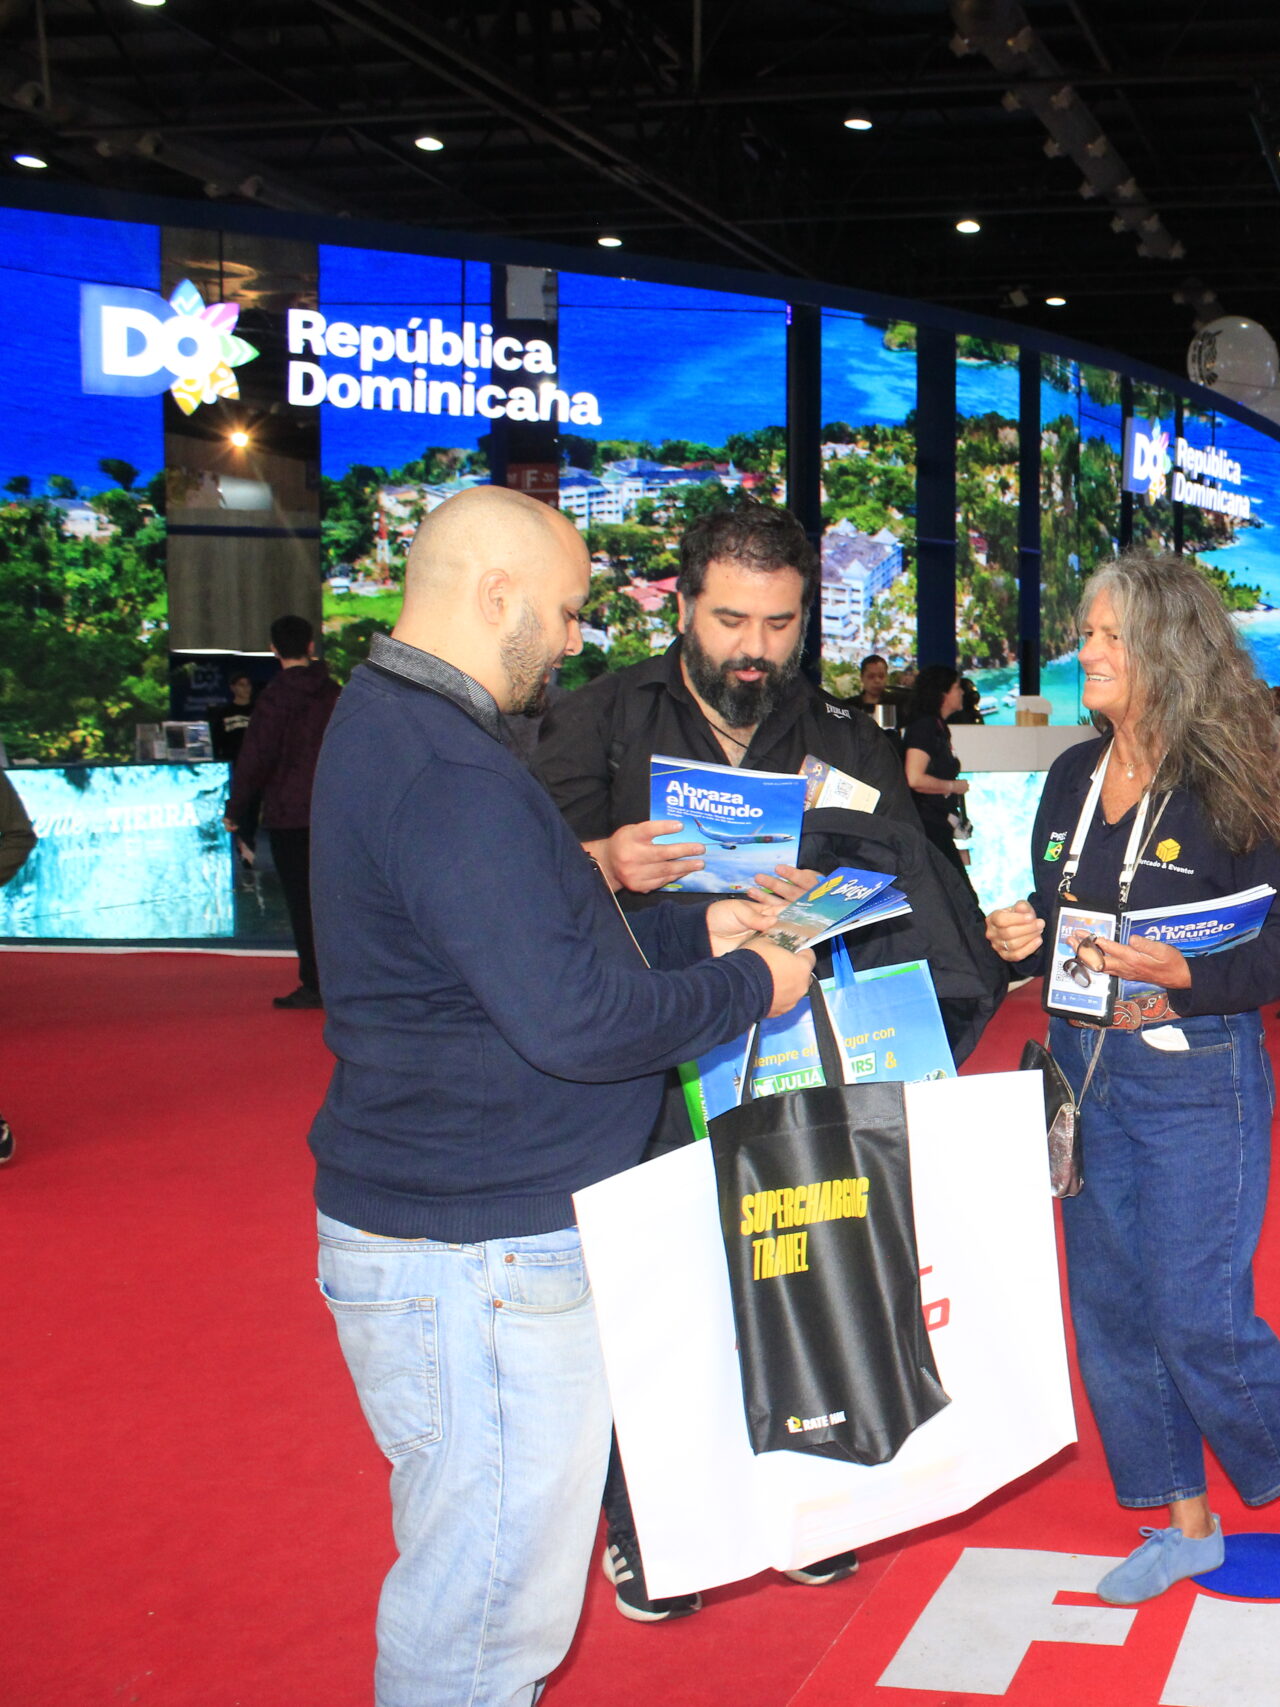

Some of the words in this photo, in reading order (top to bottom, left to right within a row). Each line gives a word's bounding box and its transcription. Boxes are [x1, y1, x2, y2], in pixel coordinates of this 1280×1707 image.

[286, 307, 557, 374] República
[286, 361, 602, 425] Dominicana
[1176, 437, 1241, 485] República
[1172, 471, 1250, 519] Dominicana
[665, 780, 744, 805] Abraza
[665, 793, 684, 808] el
[689, 796, 764, 818] Mundo
[107, 802, 201, 833] TIERRA
[1144, 920, 1218, 935] Abraza
[1166, 922, 1235, 940] Mundo
[753, 1049, 800, 1068] iempre
[844, 1033, 870, 1049] ajar
[873, 1027, 895, 1042] con
[885, 1051, 897, 1069] &
[752, 1231, 809, 1281] TRAVEL
[802, 1415, 829, 1431] RATE
